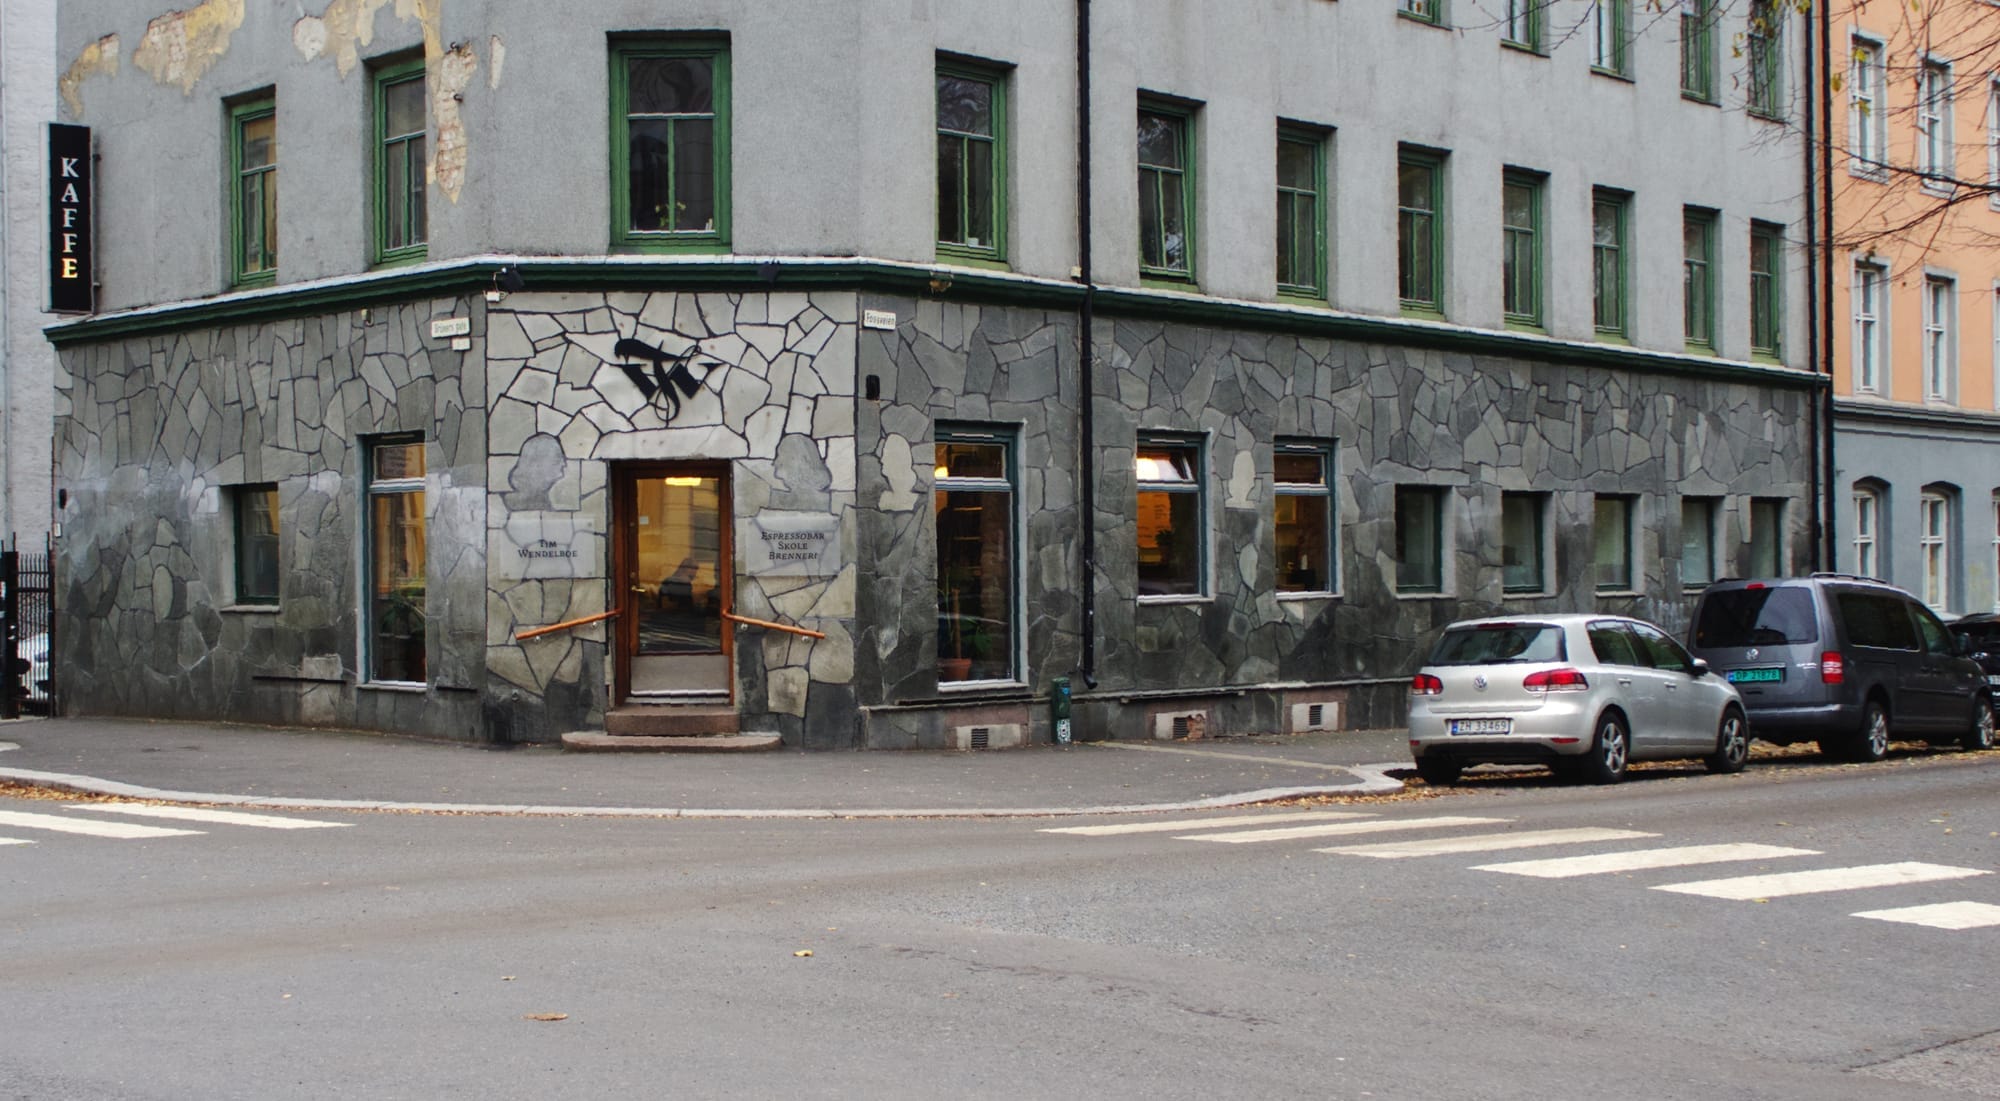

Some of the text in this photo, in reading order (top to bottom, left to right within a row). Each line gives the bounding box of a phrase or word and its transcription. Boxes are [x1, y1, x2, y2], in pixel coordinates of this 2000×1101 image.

[60, 156, 80, 279] KAFFE
[778, 541, 808, 550] SKOLE
[518, 549, 578, 558] WENDELBOE
[1459, 720, 1507, 731] ZH 33469
